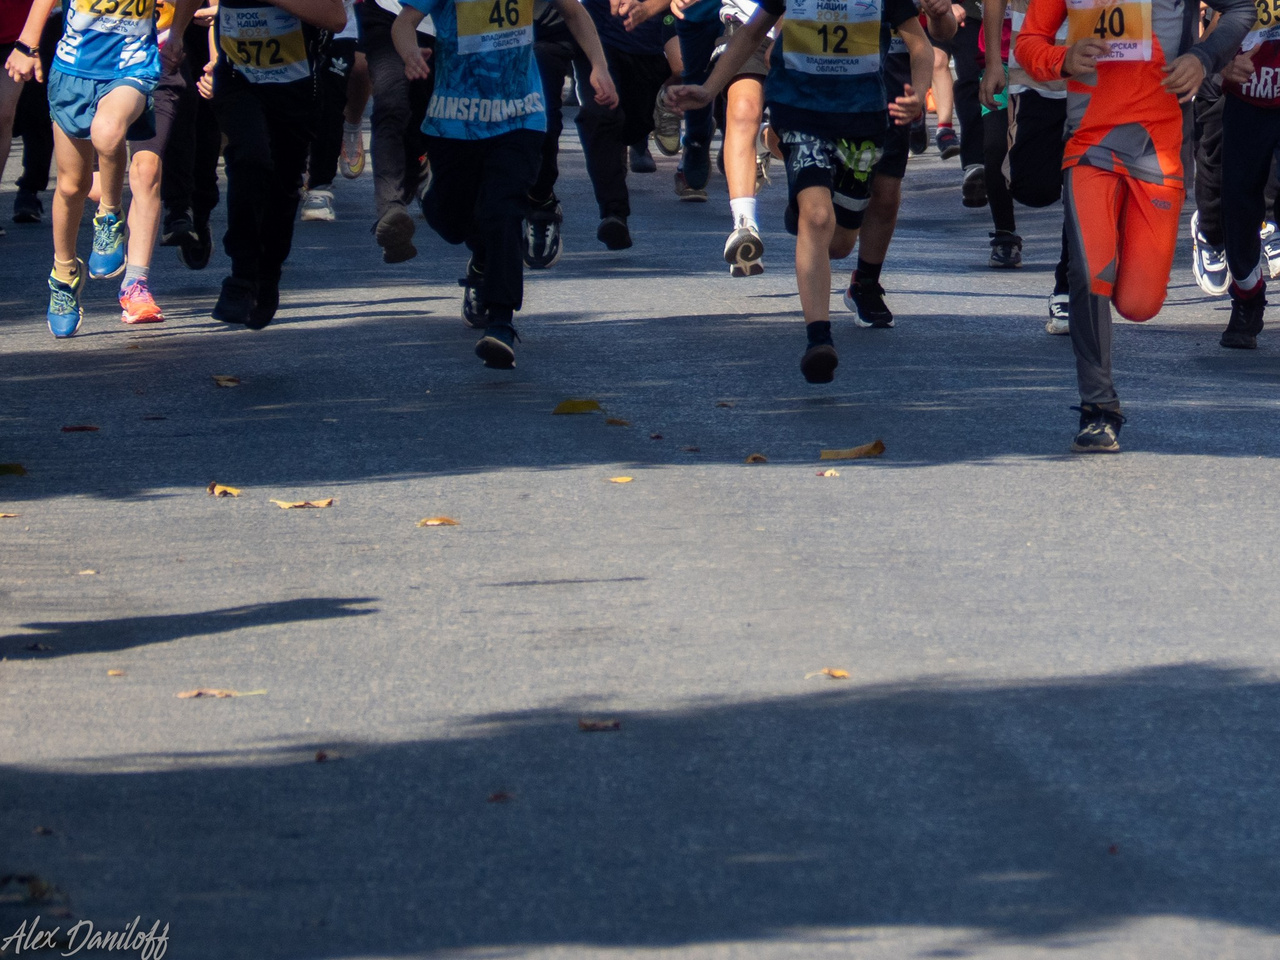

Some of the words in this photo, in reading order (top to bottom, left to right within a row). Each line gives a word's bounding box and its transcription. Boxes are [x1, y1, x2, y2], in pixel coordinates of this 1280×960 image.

[816, 2, 847, 11] НАЦИИ
[236, 12, 260, 20] КРОСС
[236, 19, 268, 29] НАЦИИ
[1094, 7, 1125, 39] 40
[481, 29, 526, 42] ВЛАДИМИРСКАЯ
[818, 24, 848, 53] 12
[493, 39, 520, 49] ОБЛАСТЬ
[236, 38, 285, 67] 572
[806, 57, 860, 65] ВЛАДИМИРСКАЯ
[816, 65, 848, 73] ОБЛАСТЬ
[1241, 82, 1280, 99] TIME
[428, 92, 544, 122] RANSFORMERS
